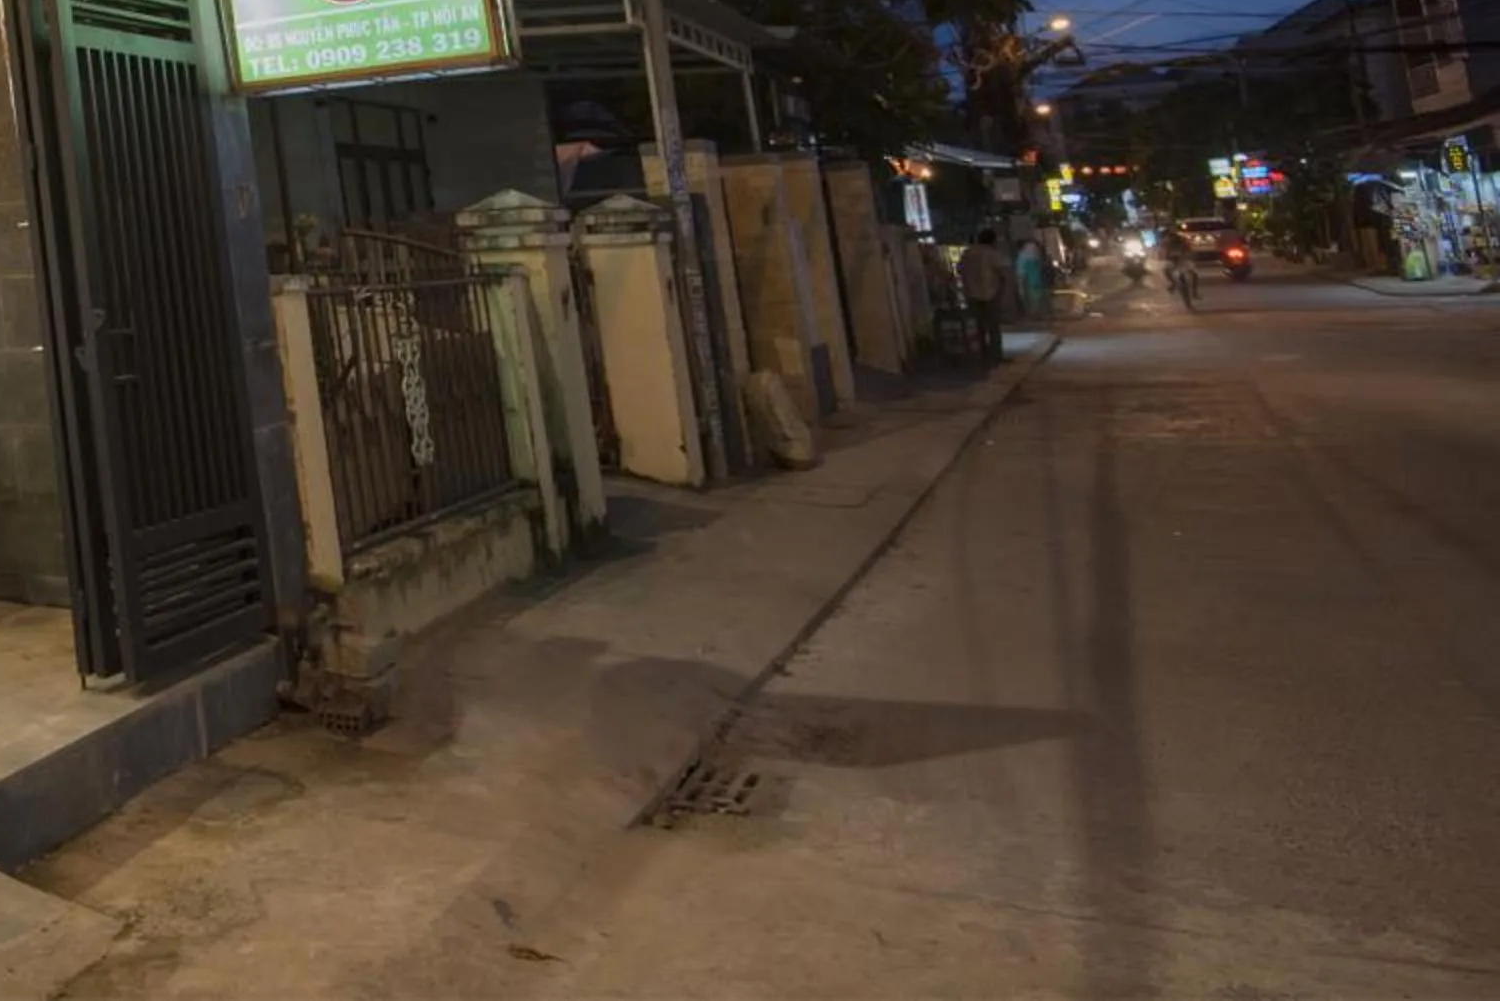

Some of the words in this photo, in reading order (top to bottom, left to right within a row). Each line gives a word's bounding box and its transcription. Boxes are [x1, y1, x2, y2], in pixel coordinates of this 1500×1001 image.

[248, 54, 299, 79] TEL:
[306, 43, 367, 72] 0909
[376, 35, 423, 60] 238
[431, 27, 481, 54] 319
